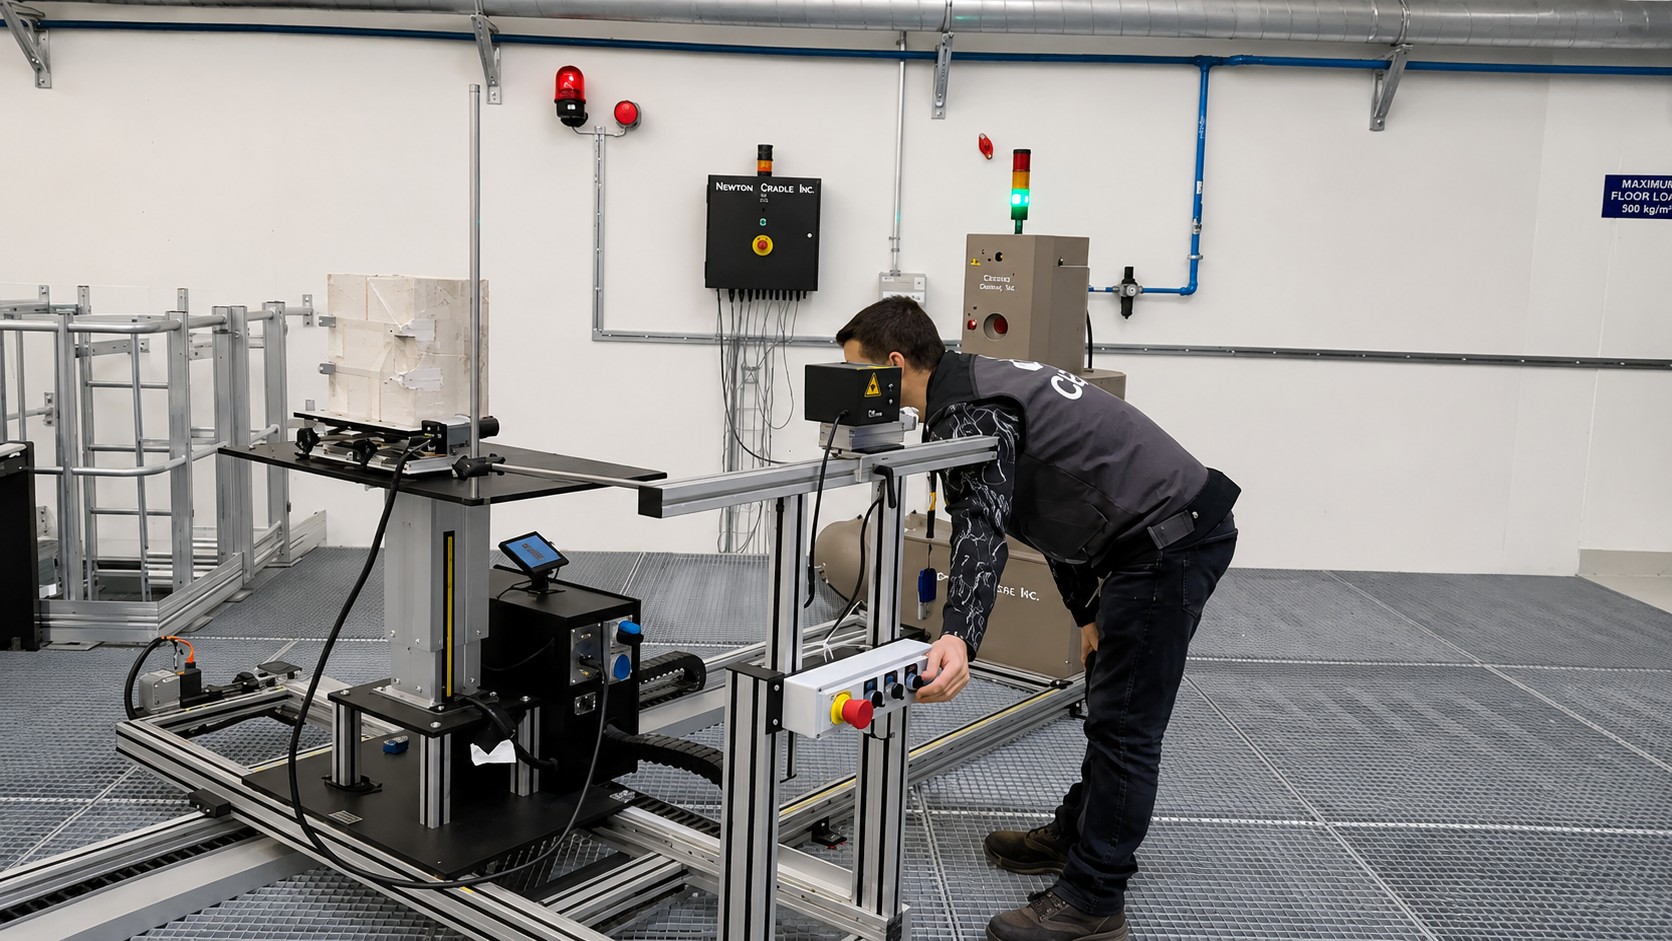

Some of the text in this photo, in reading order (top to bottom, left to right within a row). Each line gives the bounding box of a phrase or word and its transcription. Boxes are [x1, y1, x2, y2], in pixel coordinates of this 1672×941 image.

[1611, 191, 1672, 202] FLOOR LOA
[1622, 204, 1640, 213] 500
